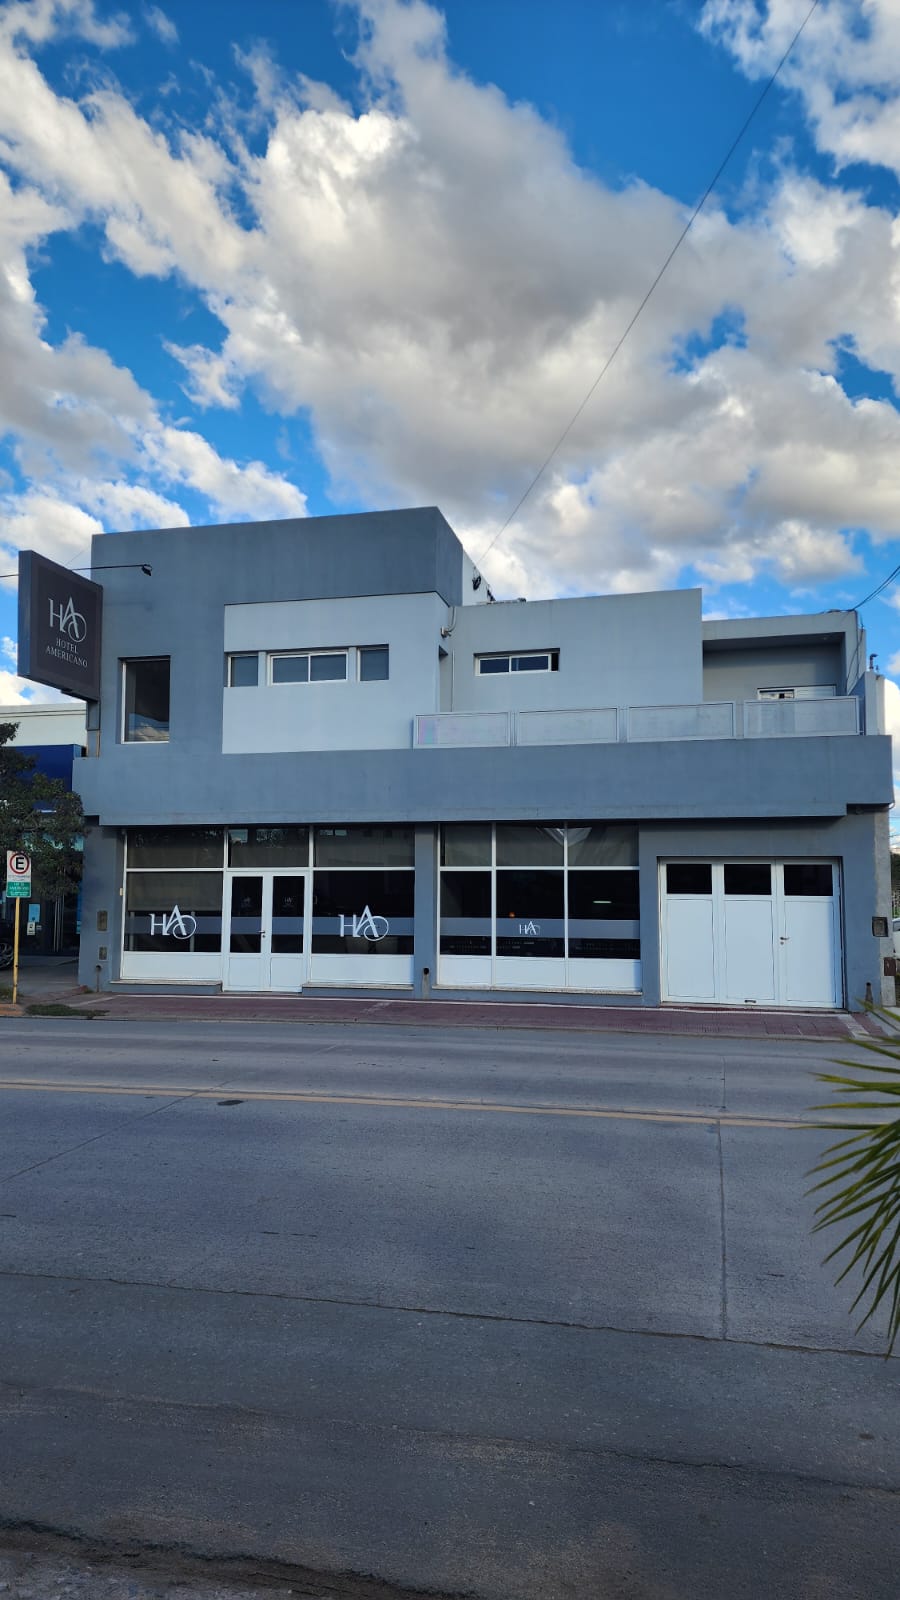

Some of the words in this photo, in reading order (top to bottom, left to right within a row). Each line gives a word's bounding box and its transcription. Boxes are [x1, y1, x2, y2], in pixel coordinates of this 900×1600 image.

[55, 637, 79, 655] HOTEL
[45, 645, 88, 669] AMERICANO
[15, 856, 25, 870] E
